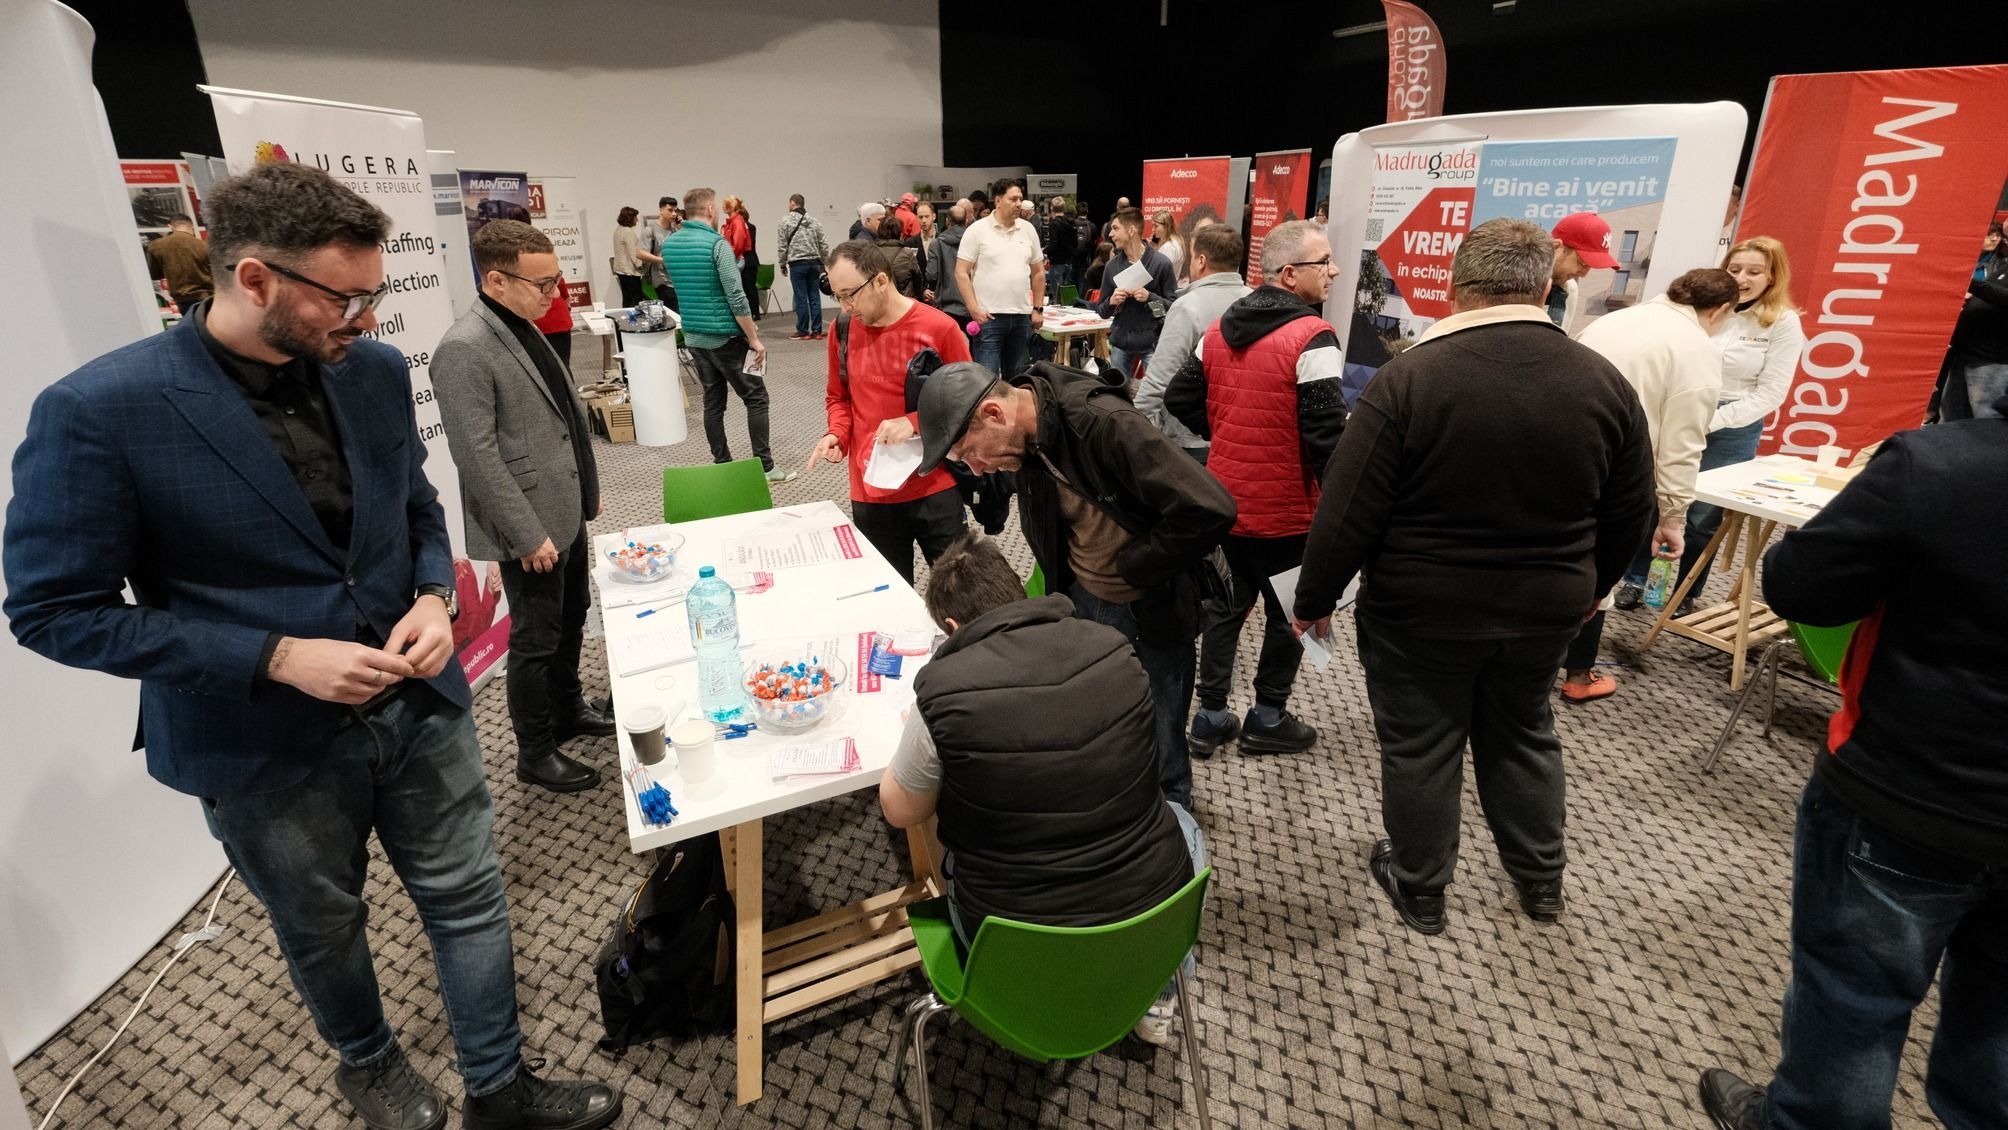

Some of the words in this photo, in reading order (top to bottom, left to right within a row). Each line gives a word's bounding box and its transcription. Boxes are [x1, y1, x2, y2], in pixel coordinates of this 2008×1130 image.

[1376, 148, 1477, 179] Madrugada
[1490, 157, 1507, 167] noi
[1509, 157, 1551, 167] suntem
[1552, 155, 1570, 167] cei
[1571, 156, 1597, 166] care
[1597, 154, 1659, 167] producem
[1170, 169, 1198, 178] Adecco
[376, 182, 423, 194] REPUBLIC
[469, 177, 520, 191] MARVICON
[1555, 177, 1580, 197] ai
[1585, 176, 1659, 197] venit
[1440, 201, 1468, 226] TE
[1403, 230, 1464, 256] VREM
[1397, 262, 1409, 277] în
[386, 272, 440, 294] lection
[1413, 287, 1448, 302] NOASTR
